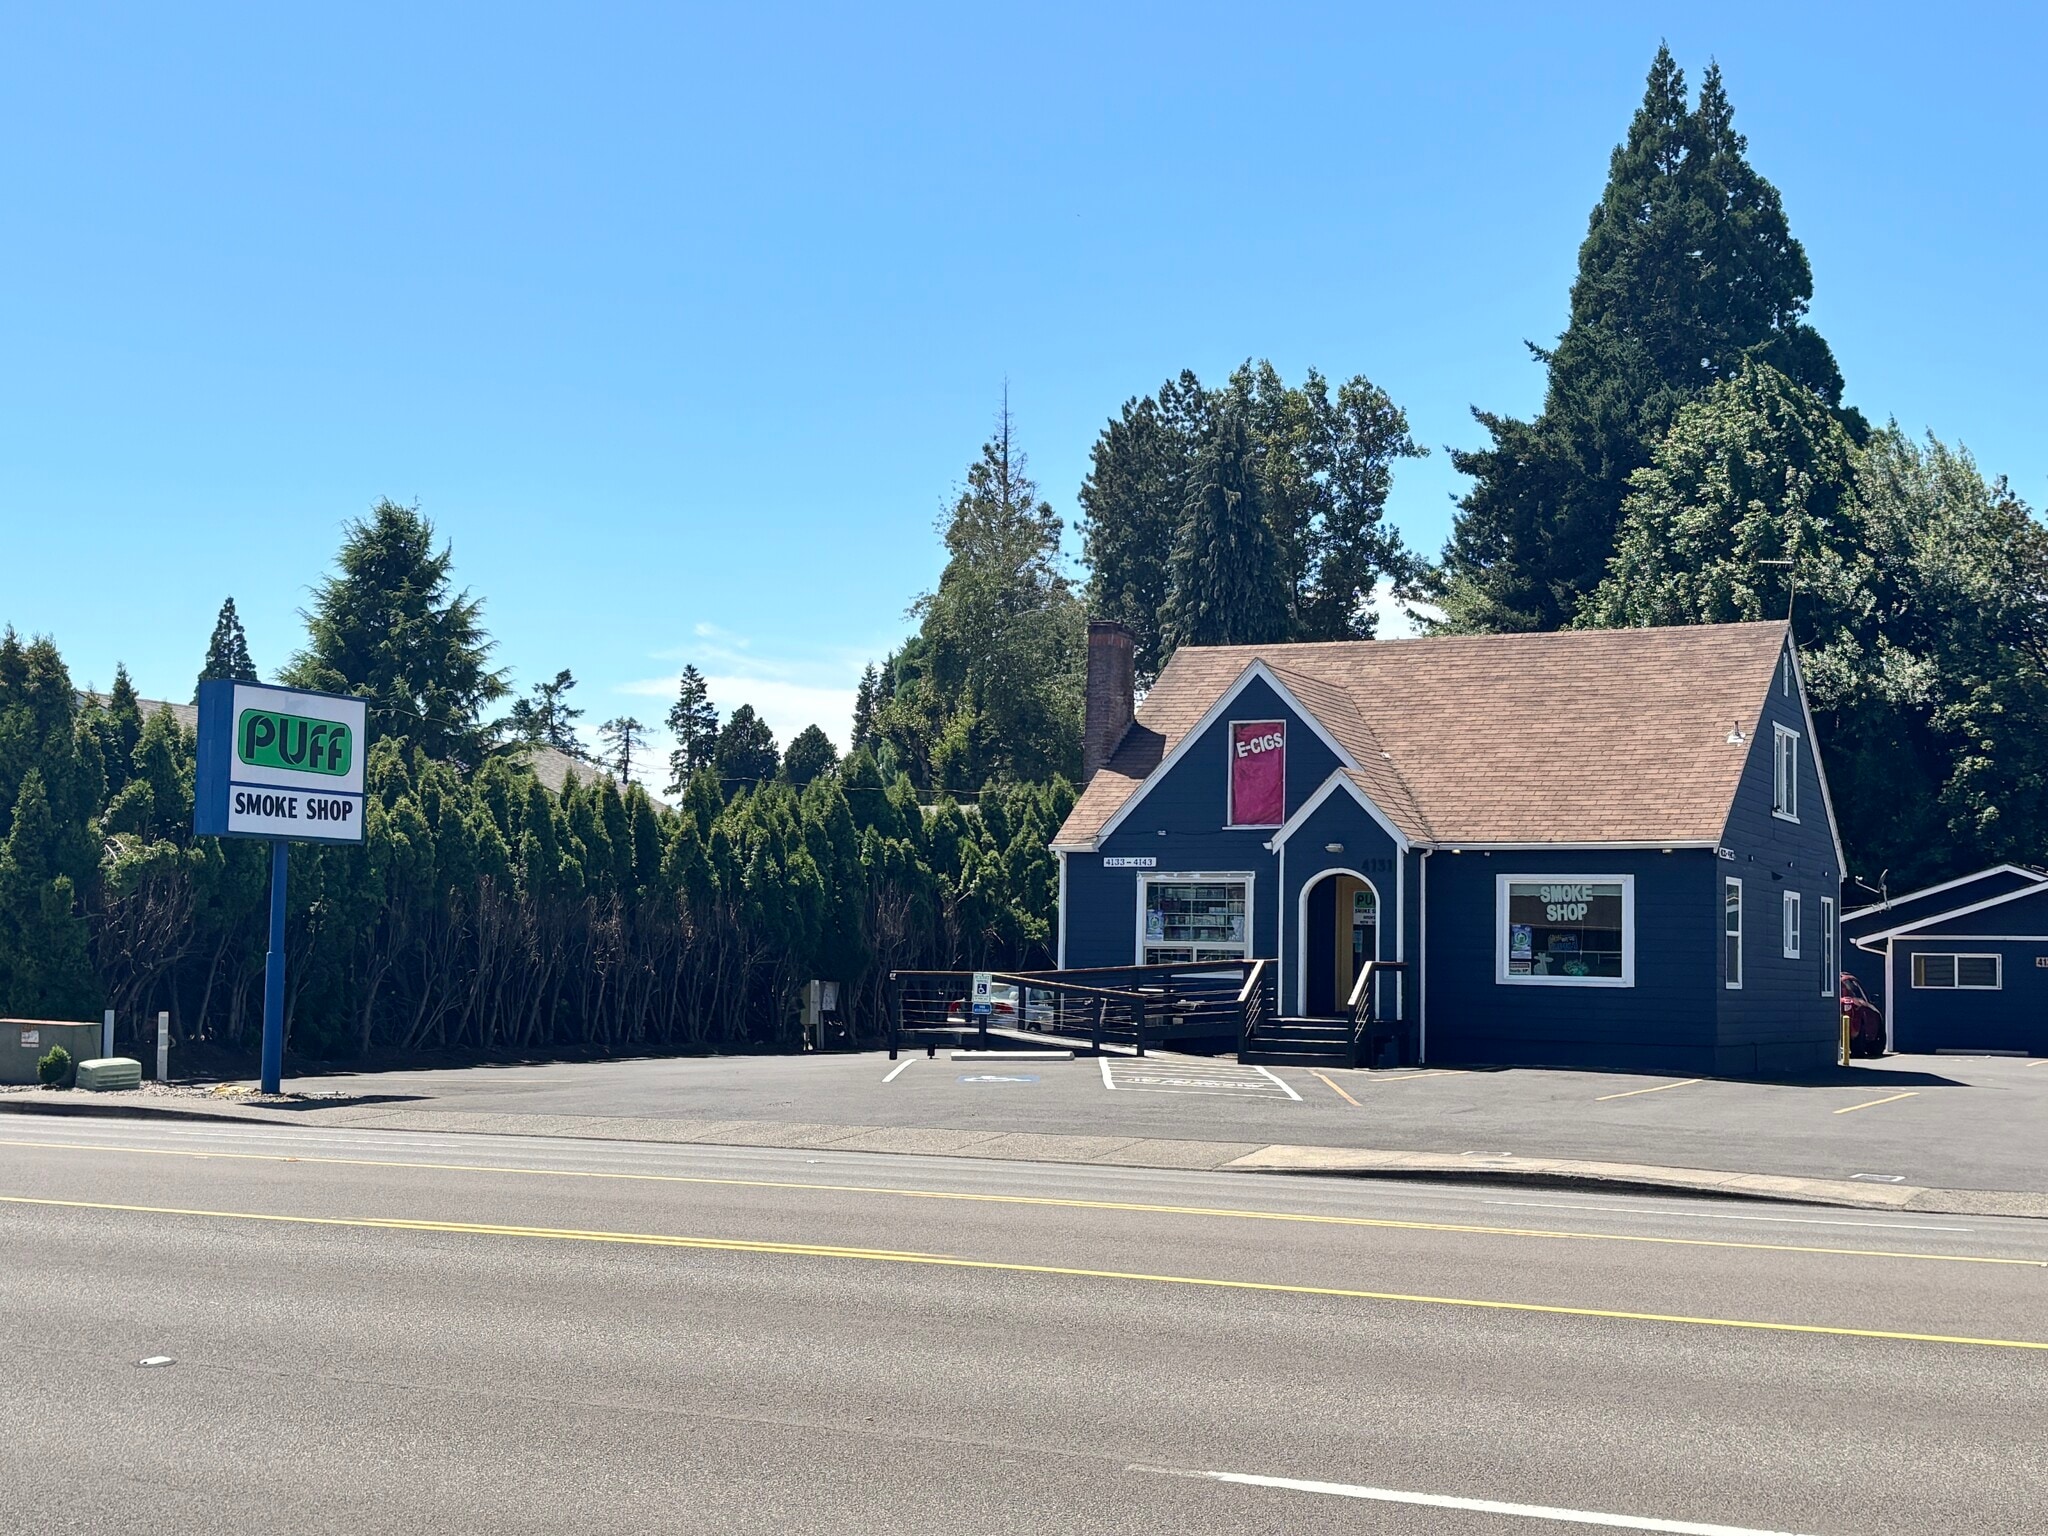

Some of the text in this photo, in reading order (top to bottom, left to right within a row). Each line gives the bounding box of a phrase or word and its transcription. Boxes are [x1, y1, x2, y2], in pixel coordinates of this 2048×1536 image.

[1236, 732, 1284, 758] E-CIGS
[234, 792, 353, 822] SMOKE SHOP
[1540, 885, 1594, 903] SMOKE
[1546, 903, 1588, 922] SHOP
[2037, 958, 2048, 967] 41
